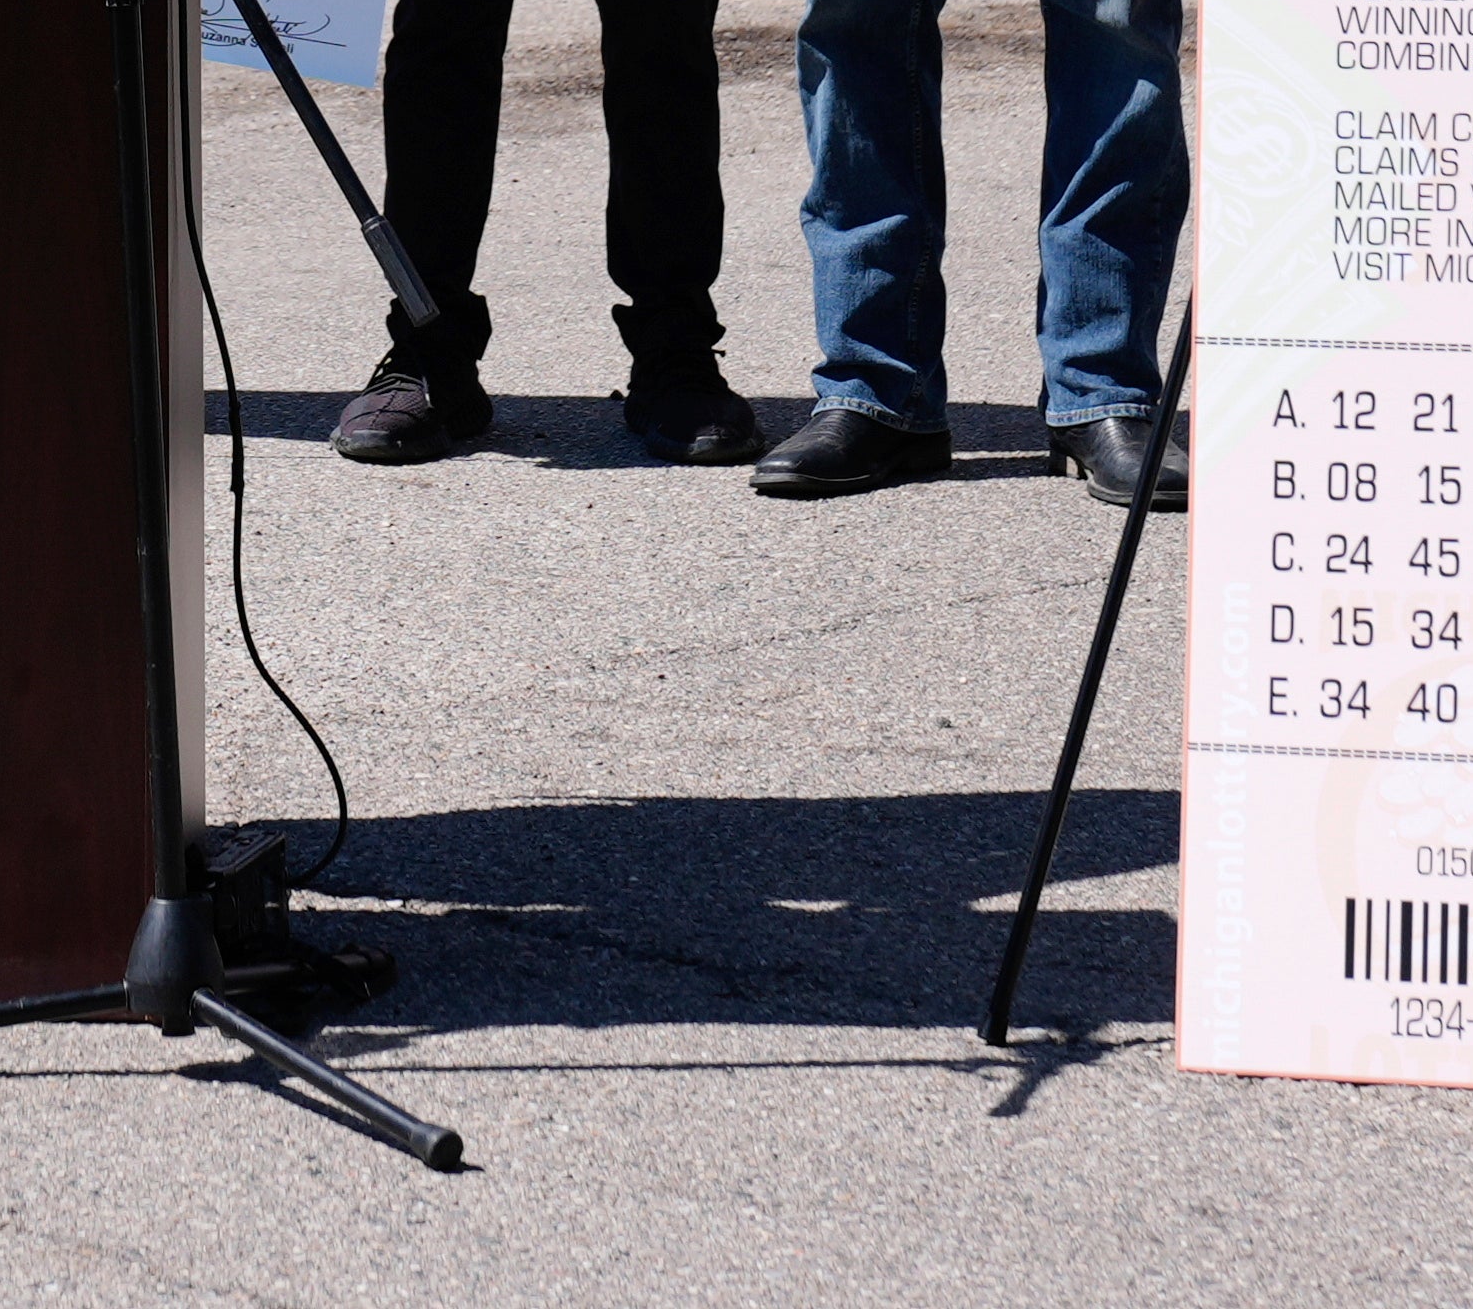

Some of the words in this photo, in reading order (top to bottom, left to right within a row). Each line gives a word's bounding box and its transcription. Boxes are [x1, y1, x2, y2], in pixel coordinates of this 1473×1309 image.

[1335, 110, 1437, 141] CLAIM
[1269, 676, 1297, 717] E.
[1320, 678, 1371, 720] 34
[1406, 682, 1458, 724] 40
